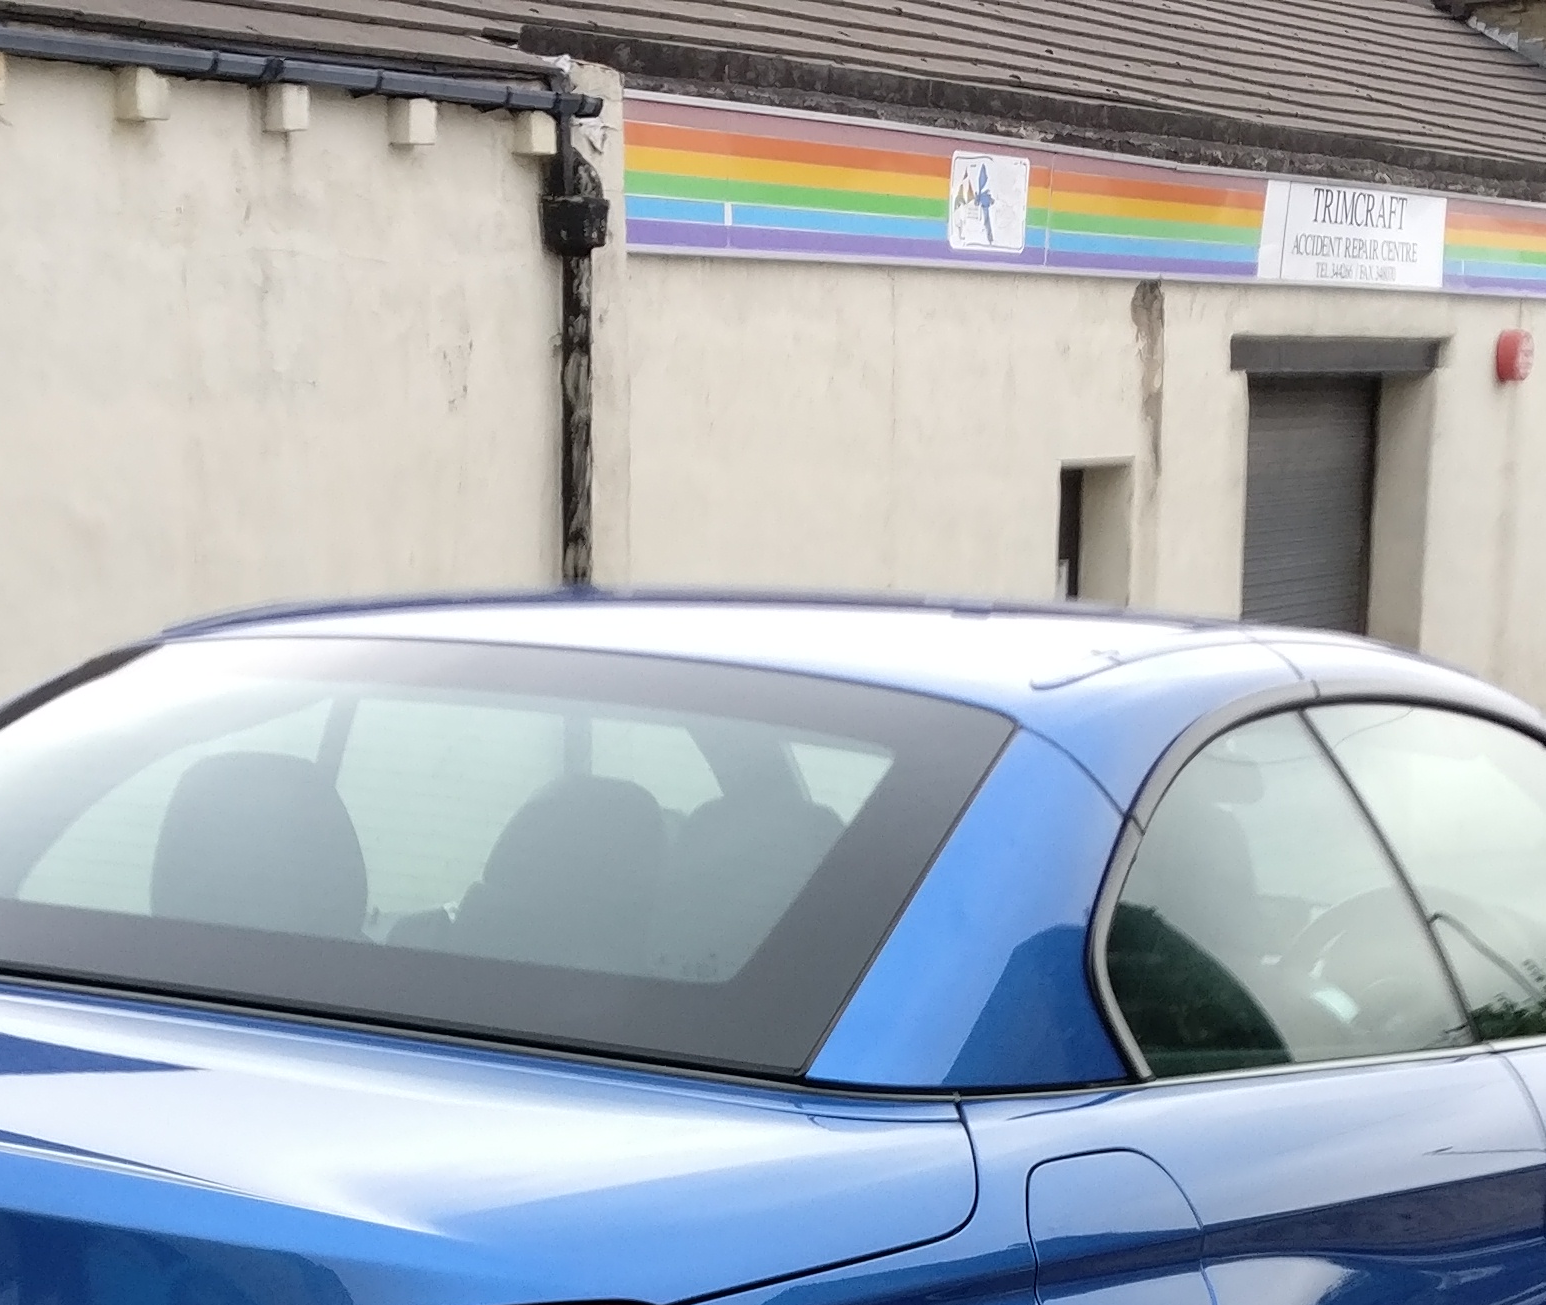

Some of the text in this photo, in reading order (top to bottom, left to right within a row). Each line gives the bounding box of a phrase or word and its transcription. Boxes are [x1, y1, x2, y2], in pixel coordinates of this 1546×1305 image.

[1313, 187, 1408, 230] TRIMCRAFT
[1292, 233, 1418, 262] ACCIDENT REPAIR CENTRE
